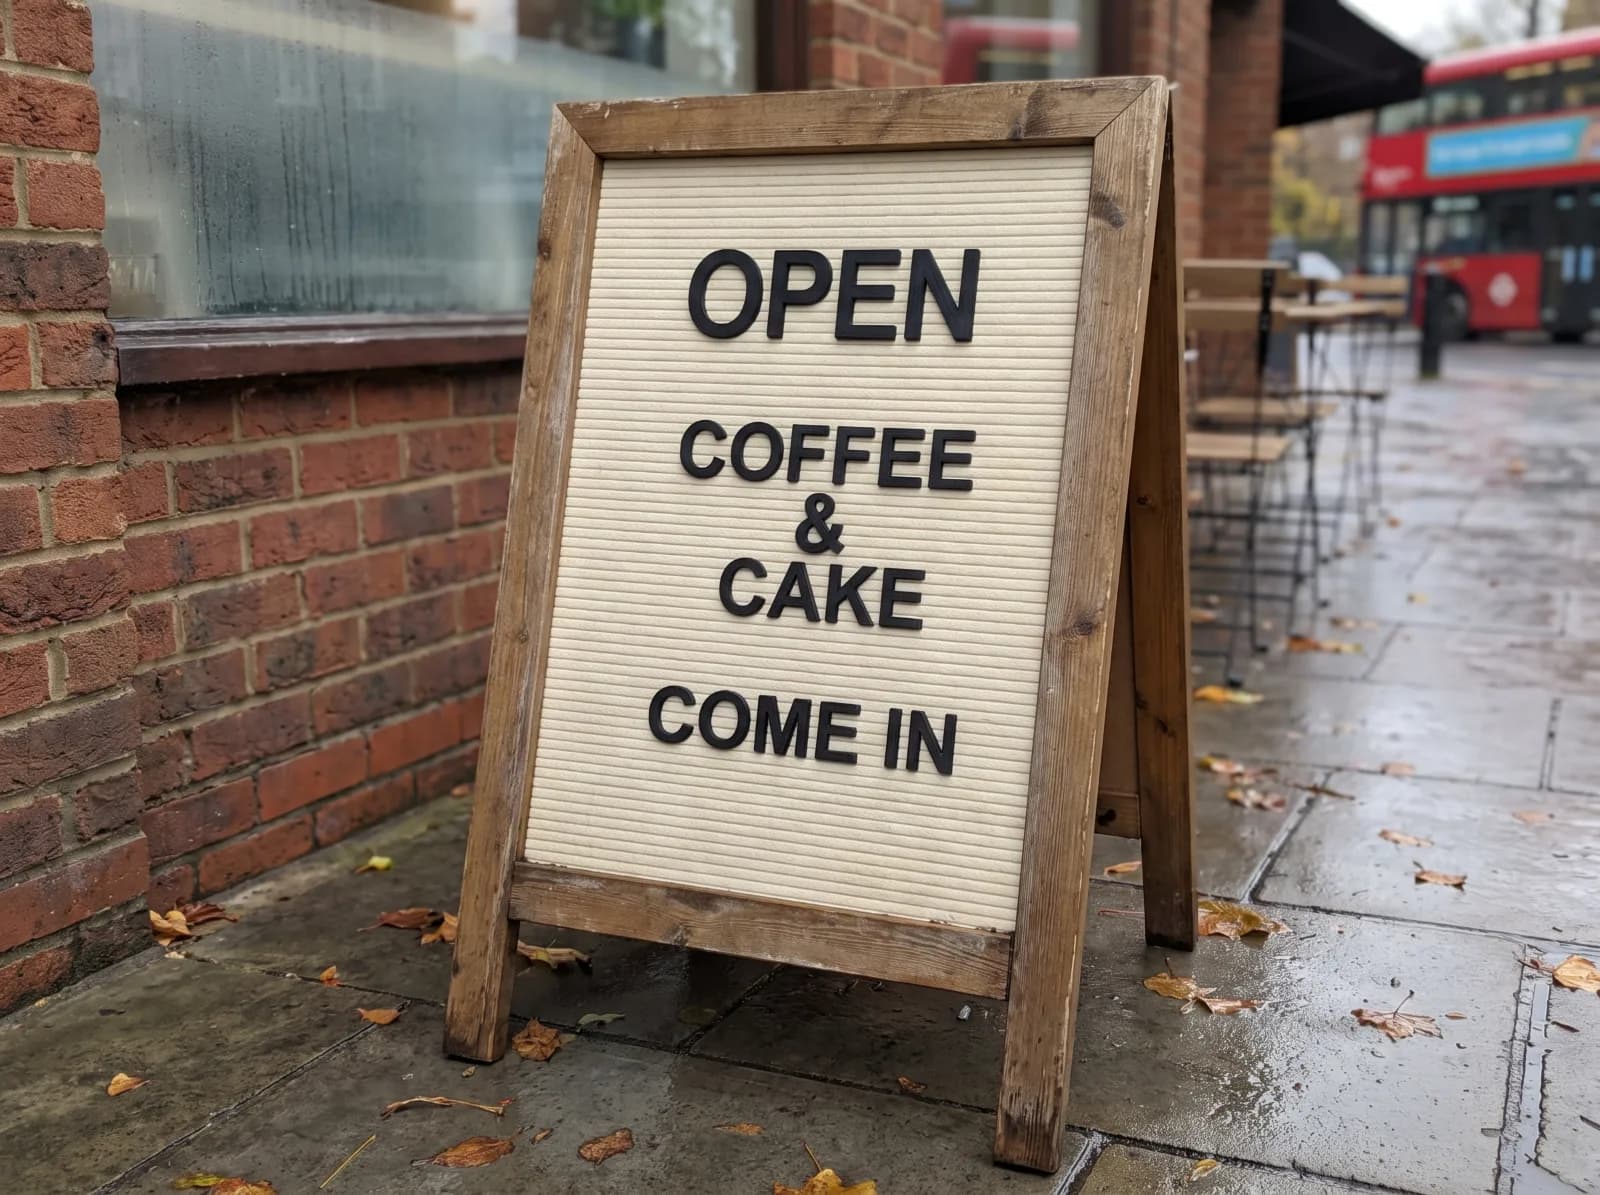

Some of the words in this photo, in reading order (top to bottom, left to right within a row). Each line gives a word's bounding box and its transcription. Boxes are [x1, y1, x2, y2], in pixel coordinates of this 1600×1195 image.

[688, 248, 981, 344] OPEN
[679, 419, 977, 492] COFFEE
[794, 492, 845, 556] &
[718, 557, 926, 631] CAKE
[648, 685, 862, 766] COME
[883, 707, 958, 777] IN
